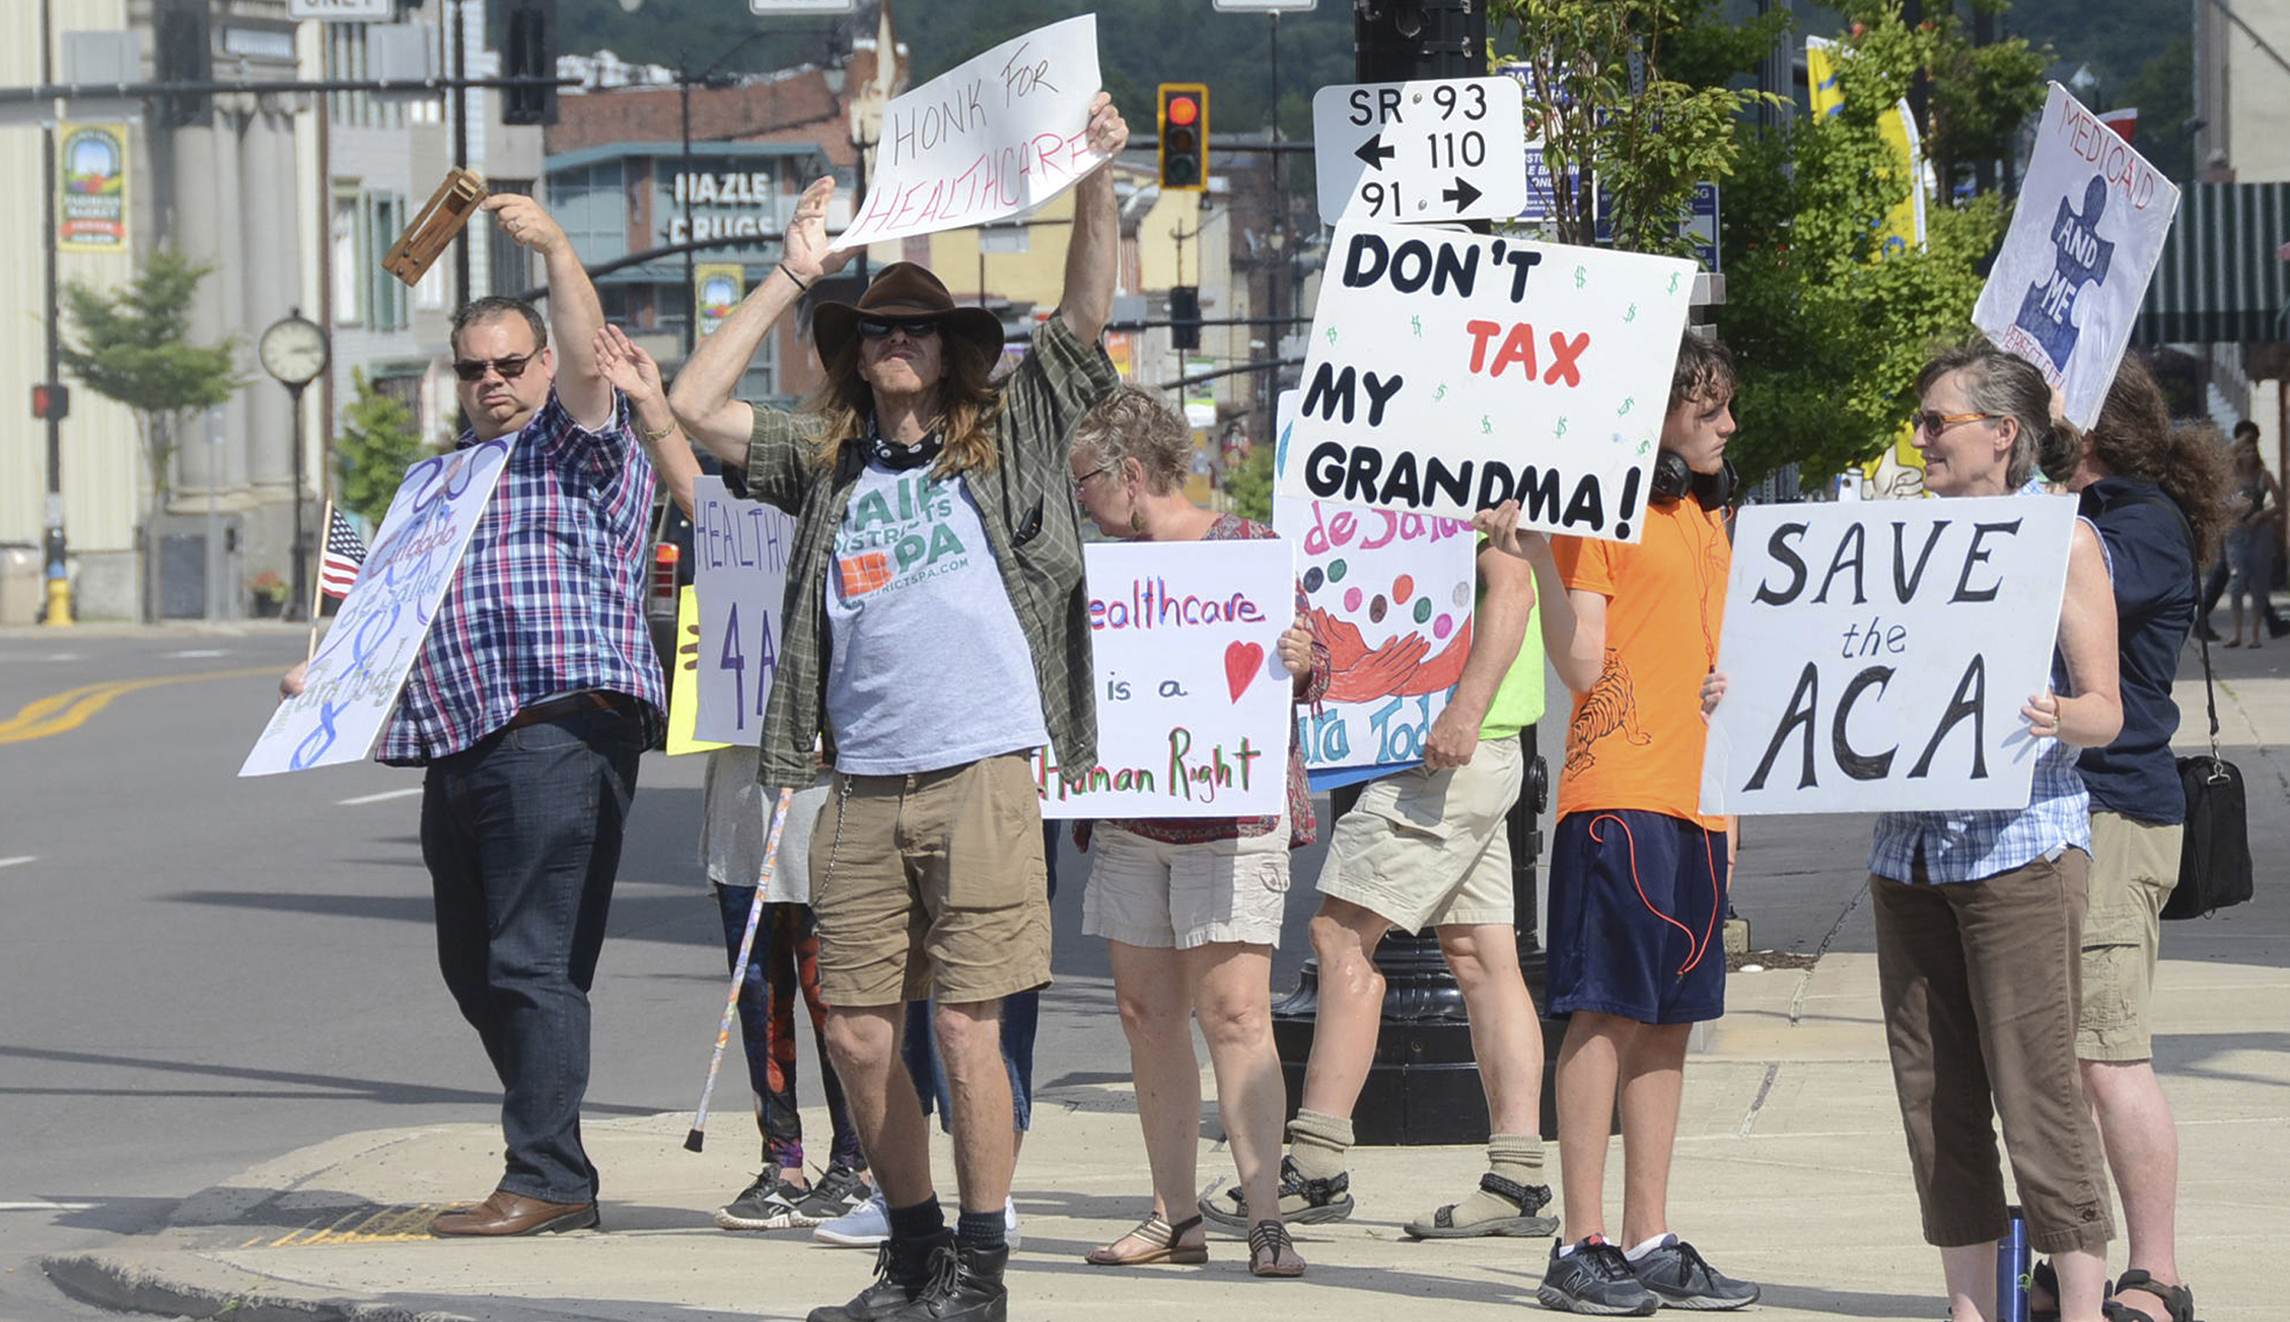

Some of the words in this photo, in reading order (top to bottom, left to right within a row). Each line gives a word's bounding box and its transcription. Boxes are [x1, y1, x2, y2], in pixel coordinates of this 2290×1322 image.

[894, 78, 987, 166] HONK
[1001, 42, 1059, 109] FOR
[1349, 88, 1403, 126] SR
[1433, 84, 1487, 121] 93
[1427, 131, 1486, 169] 110
[2058, 100, 2154, 210] MEDICAID
[674, 172, 770, 203] HAZLE
[851, 127, 1098, 238] HEALTHCARE
[1361, 181, 1400, 218] 91
[669, 216, 774, 245] DRUGS
[2057, 216, 2098, 269] AND
[1343, 234, 1541, 303] DON'T
[2040, 270, 2077, 324] ME
[1467, 320, 1590, 387] TAX
[1301, 362, 1403, 427] MY
[843, 474, 948, 530] AIR
[1305, 441, 1641, 540] GRANDMA!
[895, 522, 966, 574] PA
[1304, 501, 1358, 556] de
[1752, 517, 2023, 606] SAVE
[1089, 575, 1267, 630] ealthcare
[1842, 617, 1906, 659] the
[721, 602, 745, 731] 4
[756, 609, 777, 717] A
[1107, 671, 1131, 701] is
[1159, 680, 1188, 698] a
[1300, 707, 1351, 765] ra
[1370, 684, 1460, 765] Tod
[1742, 653, 1989, 792] ACA
[1169, 726, 1262, 804] Right
